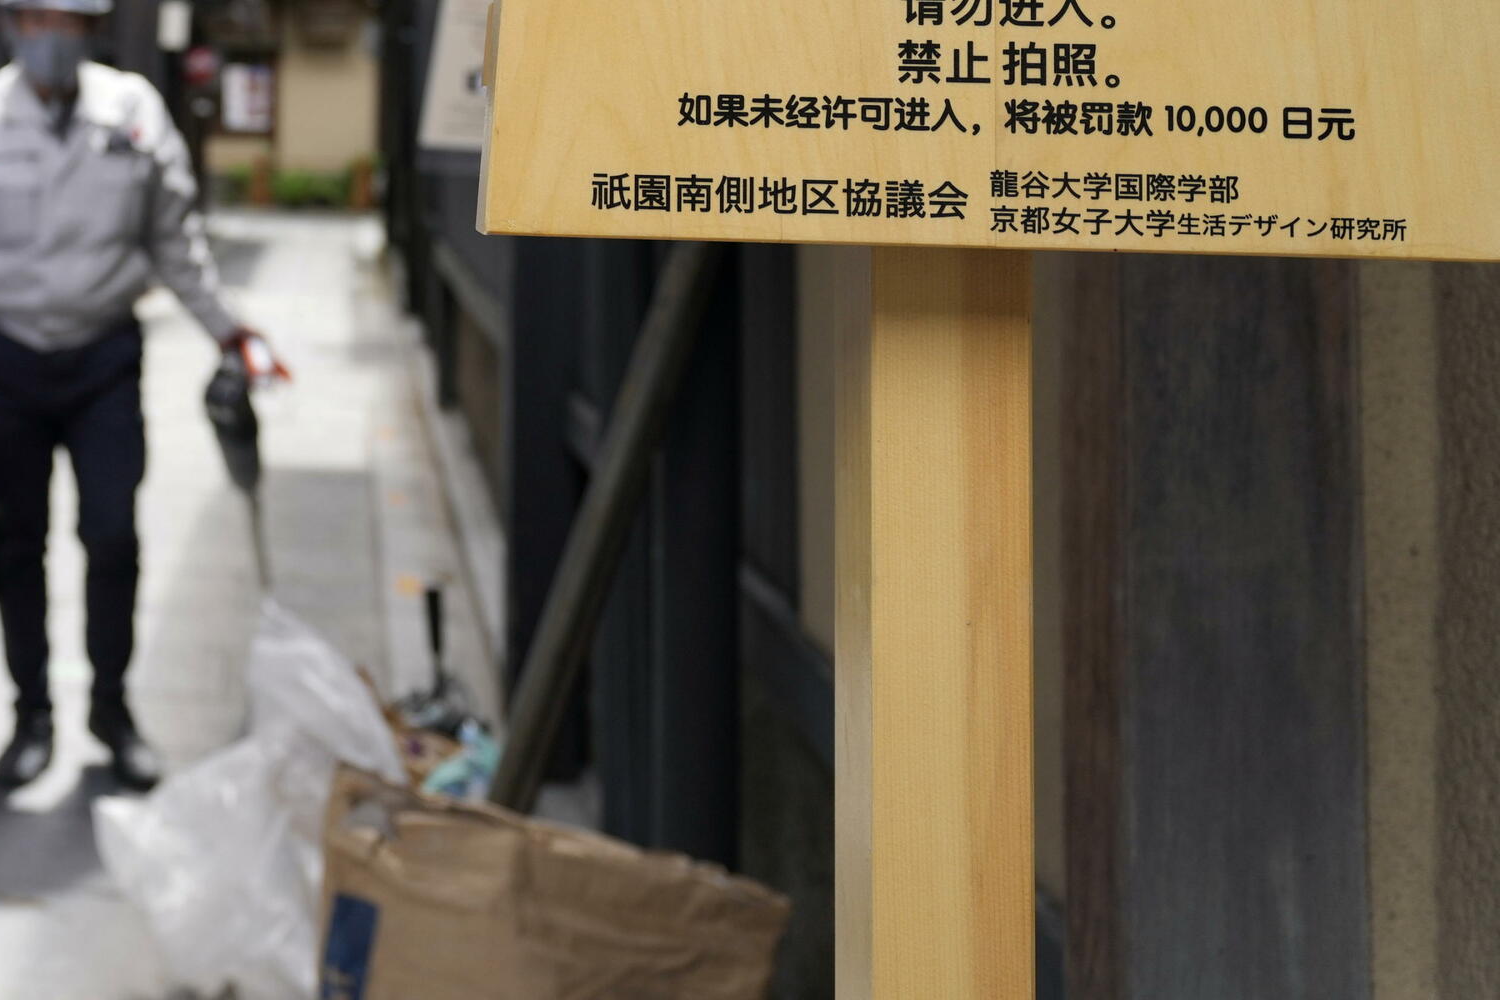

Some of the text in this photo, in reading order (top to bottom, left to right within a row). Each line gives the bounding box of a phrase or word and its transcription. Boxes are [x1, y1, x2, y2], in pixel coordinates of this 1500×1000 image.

[990, 170, 1238, 204] 龍谷大学国際学部
